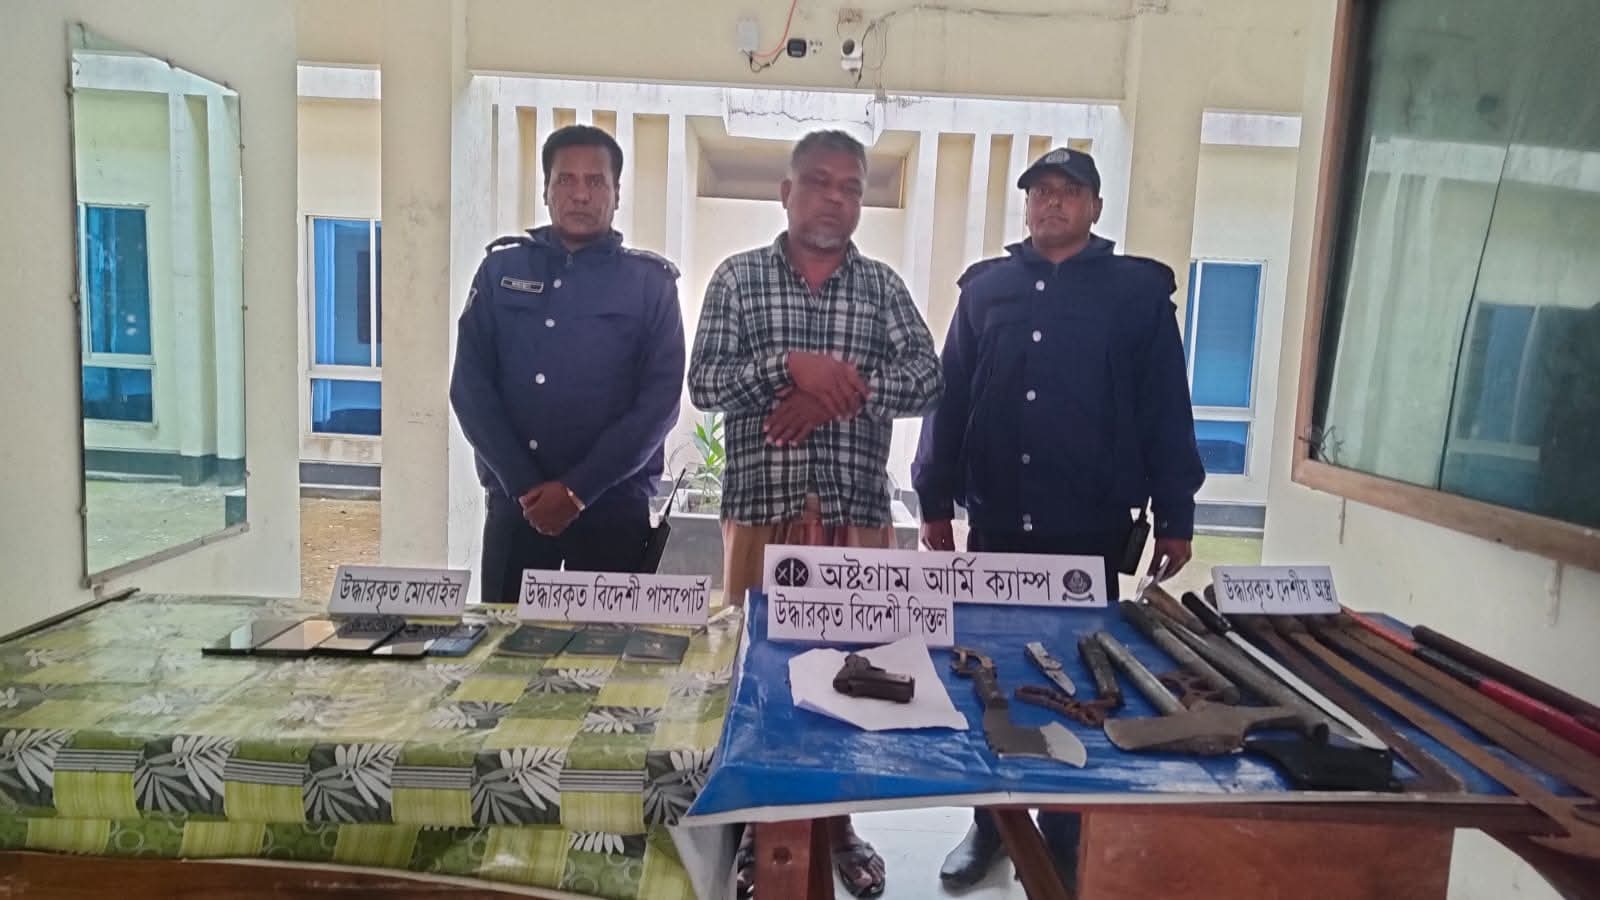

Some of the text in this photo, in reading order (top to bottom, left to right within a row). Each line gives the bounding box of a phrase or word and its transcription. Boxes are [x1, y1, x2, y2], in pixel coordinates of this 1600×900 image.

[340, 571, 462, 615] উদ্ধারকৃত মোবাইল
[525, 574, 706, 622] উদ্ধারকৃত বিদেশী পাসপোর্ট
[922, 557, 976, 598] আর্মি
[983, 567, 1050, 601] ক্যাম্প
[1223, 573, 1274, 612] উদ্ধারকৃত
[1275, 569, 1312, 603] দেশীয়
[775, 593, 948, 640] উদ্ধারকৃত বিদেশী পিস্তল
